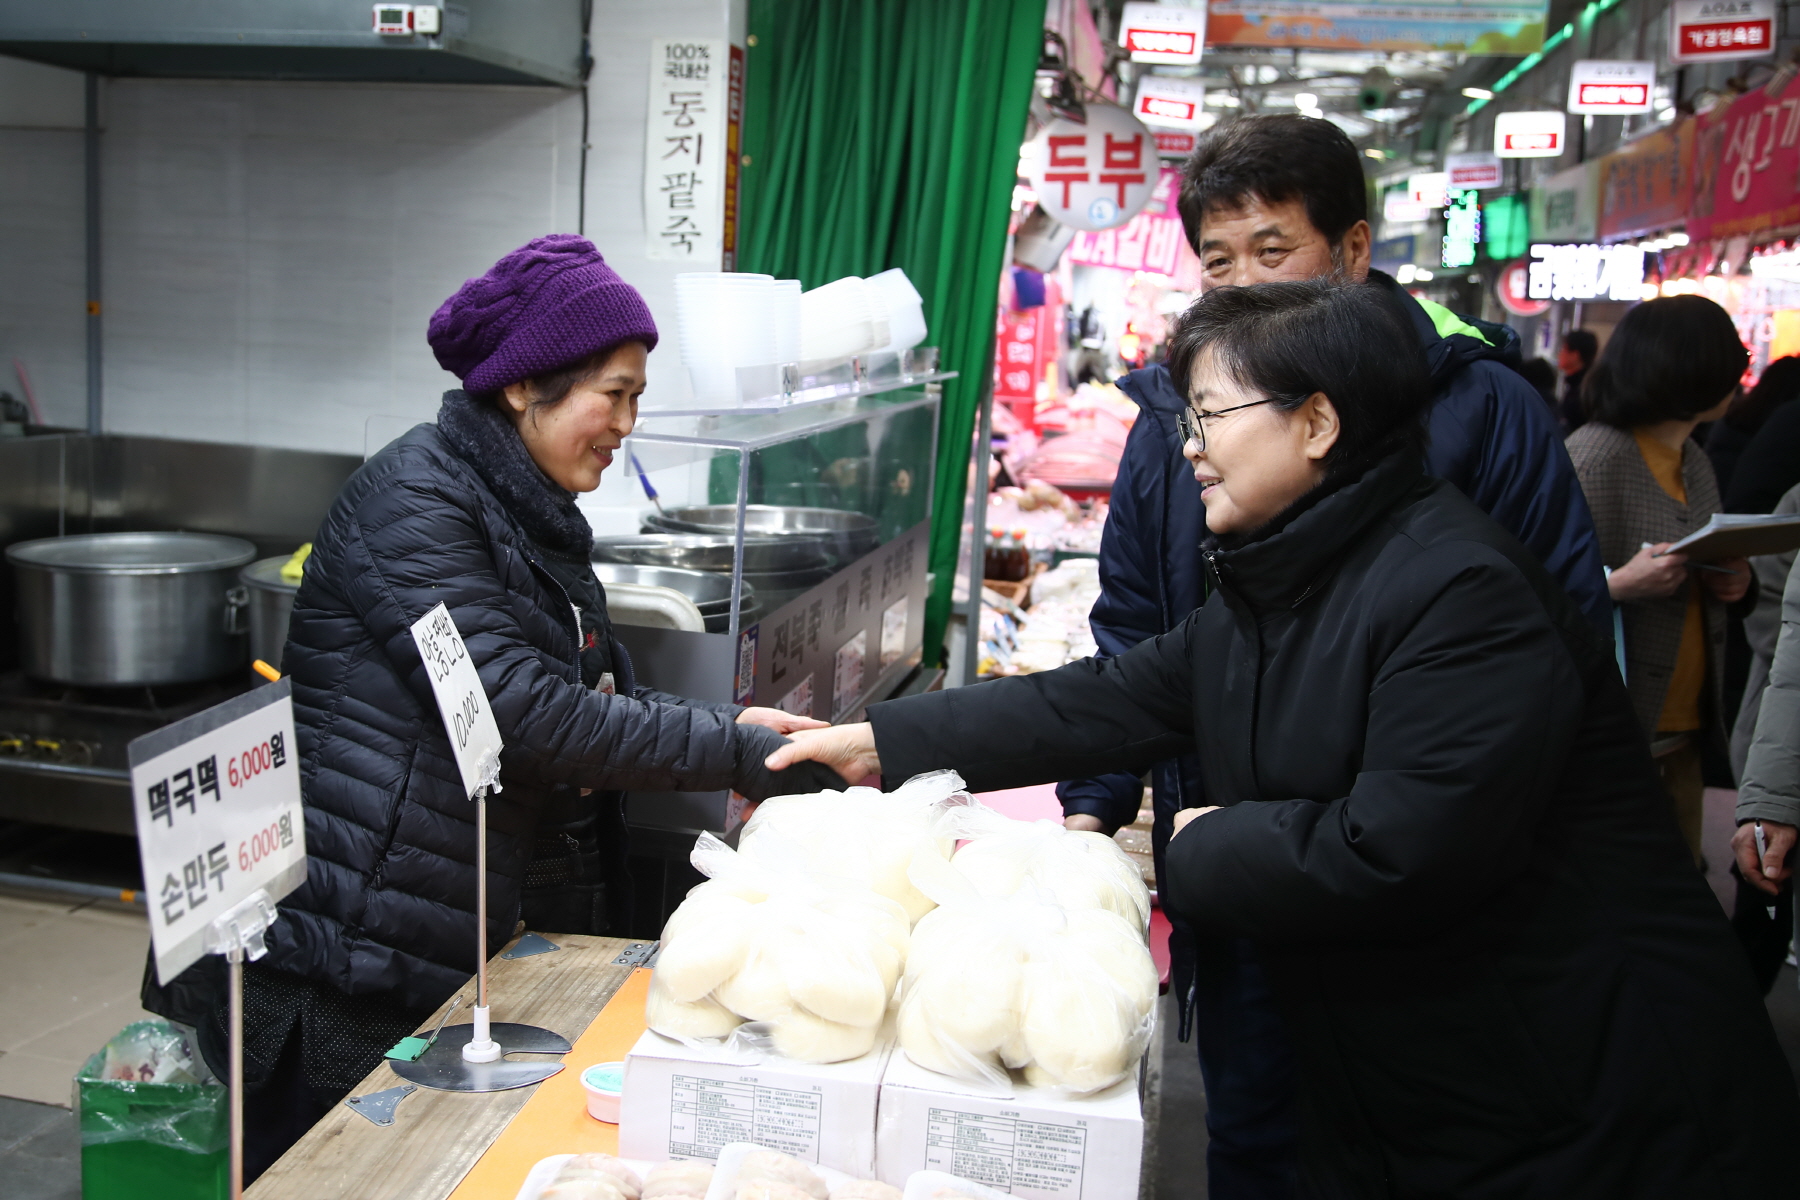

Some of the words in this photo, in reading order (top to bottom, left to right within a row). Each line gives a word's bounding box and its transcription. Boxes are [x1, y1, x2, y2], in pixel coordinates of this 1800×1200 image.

[664, 62, 709, 80] 국내산
[666, 44, 709, 60] 100%
[660, 91, 706, 254] 동지팥죽
[1044, 132, 1146, 210] 두부
[772, 598, 822, 684] 전복죽
[147, 754, 222, 828] 떡국떡
[227, 731, 287, 789] 6,000원
[160, 841, 230, 927] 손만두
[238, 810, 294, 873] 6,000원
